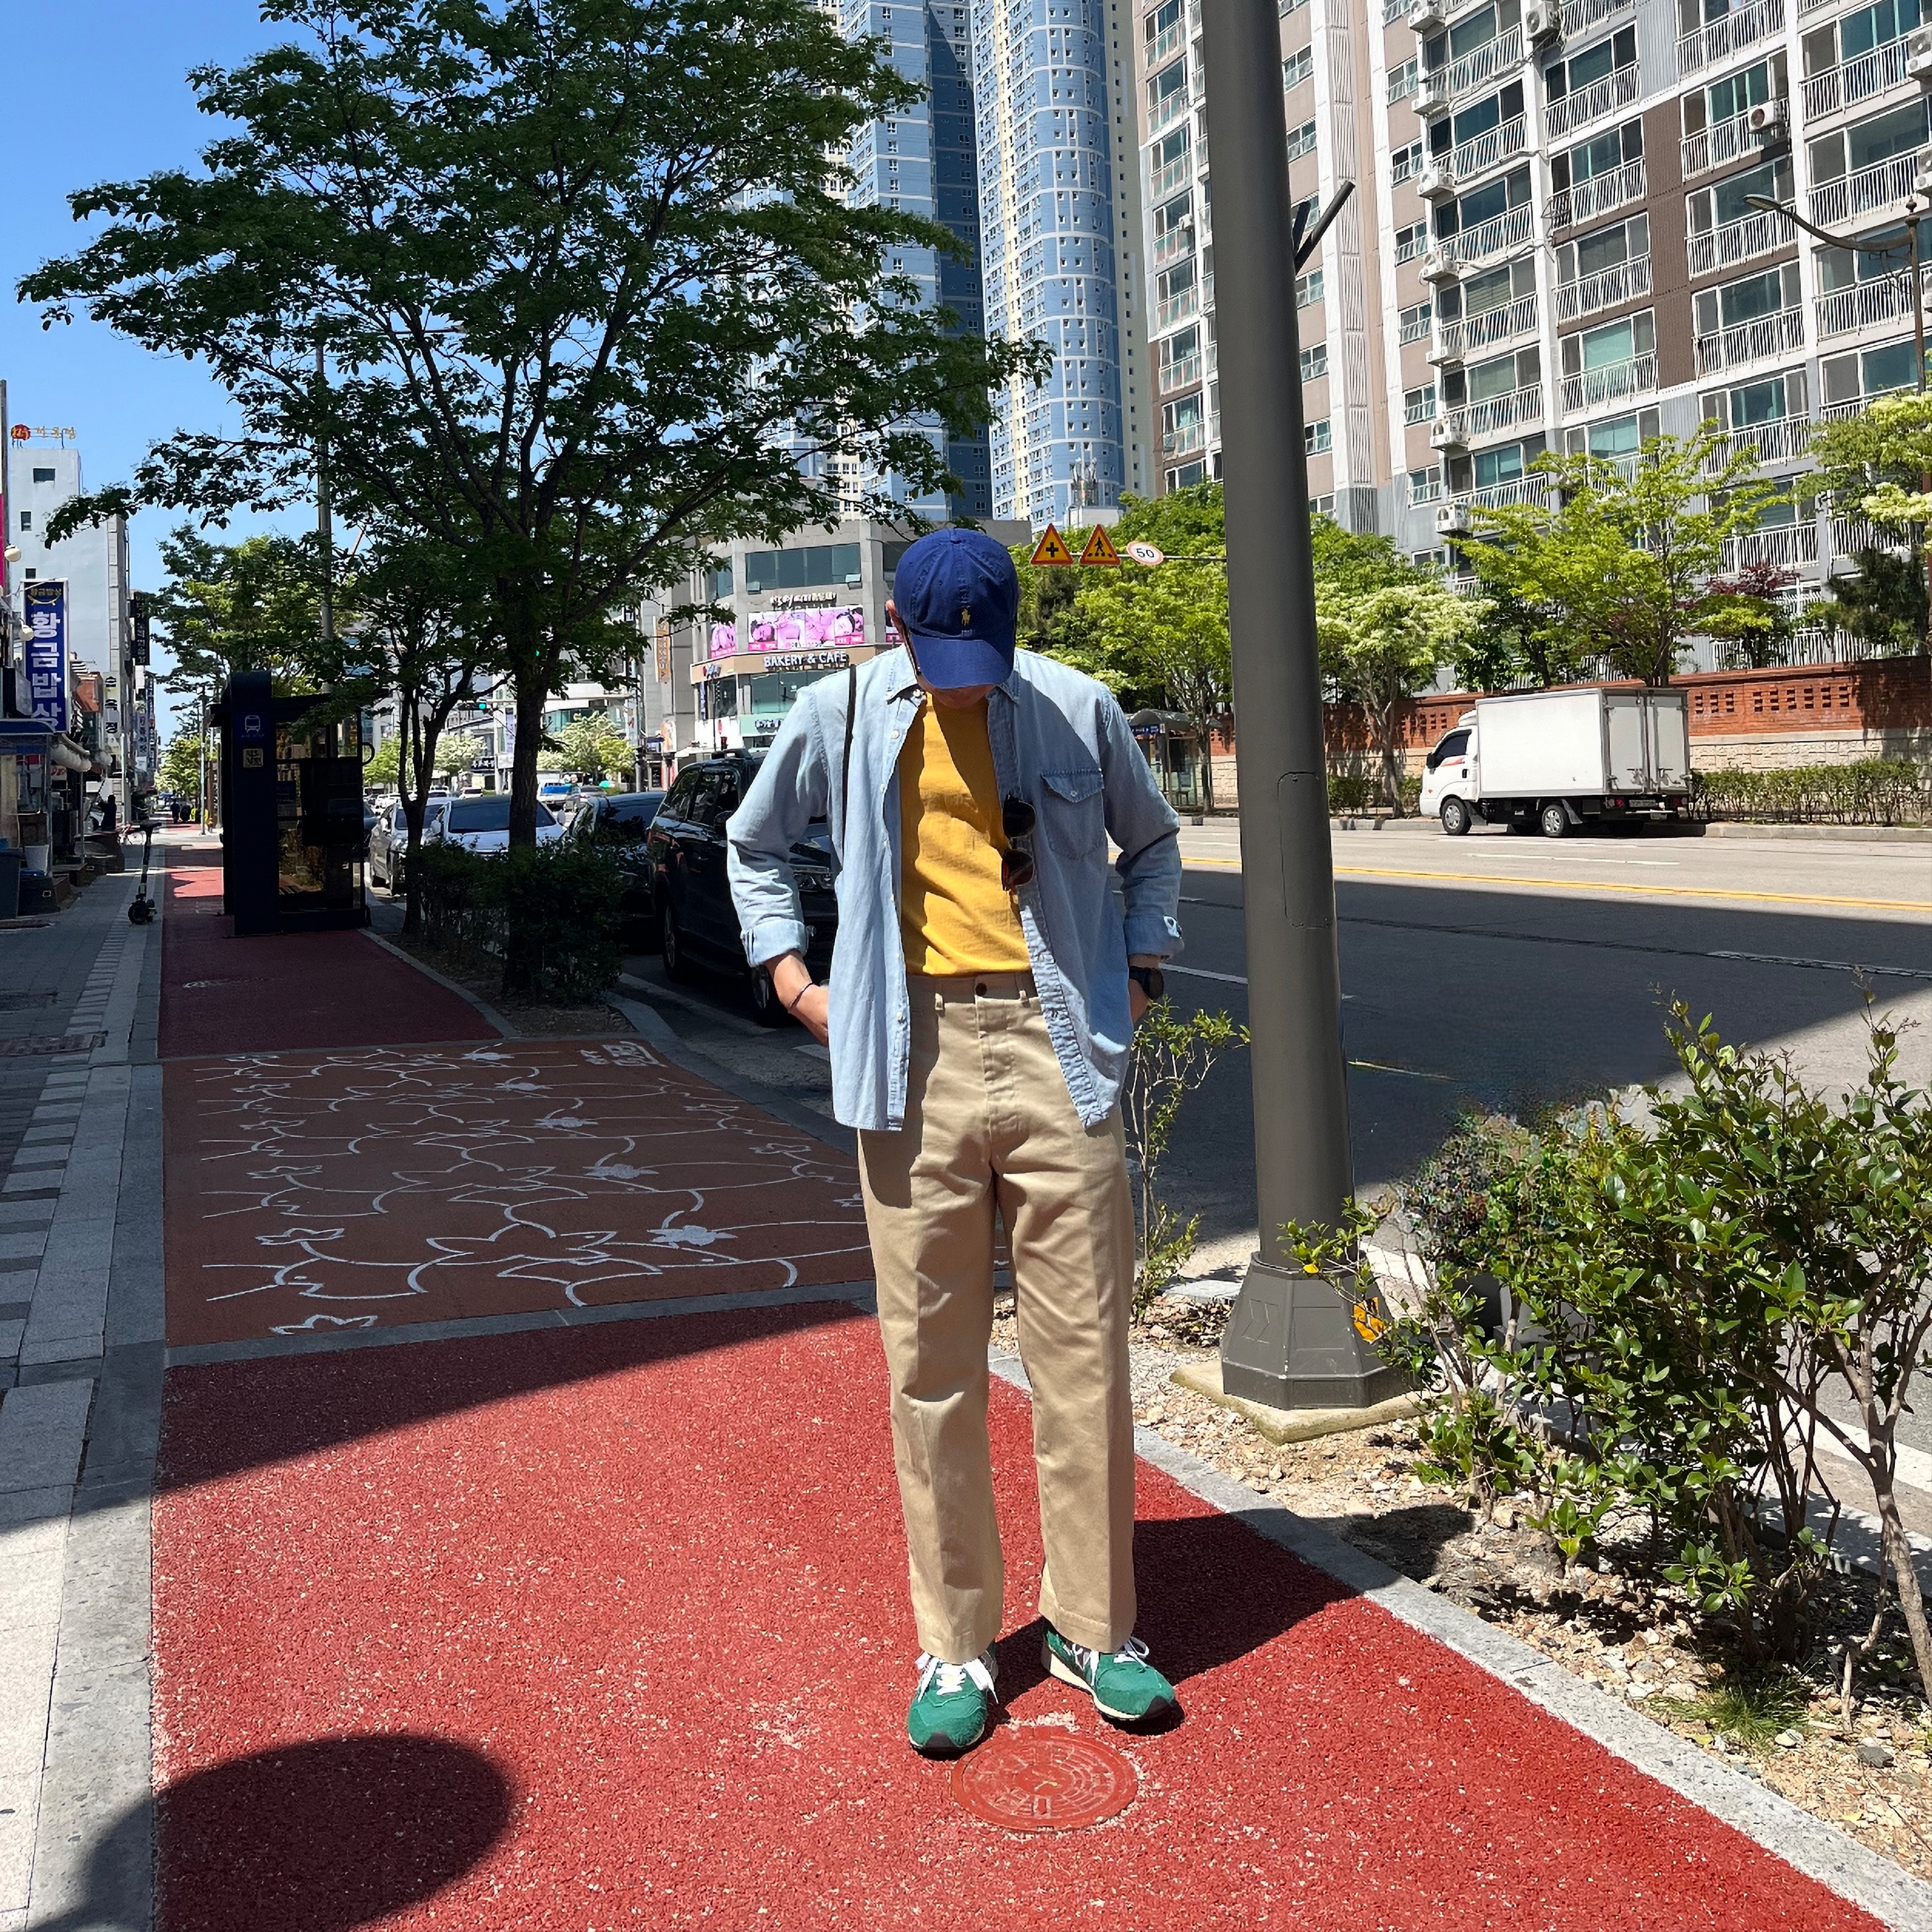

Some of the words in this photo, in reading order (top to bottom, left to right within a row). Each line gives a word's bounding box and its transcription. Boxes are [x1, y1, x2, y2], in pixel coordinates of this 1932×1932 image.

[1136, 548, 1154, 558] 50
[763, 654, 804, 667] BAKERY
[807, 653, 816, 664] &
[819, 650, 847, 663] CAFE
[31, 611, 61, 727] 황금밥상
